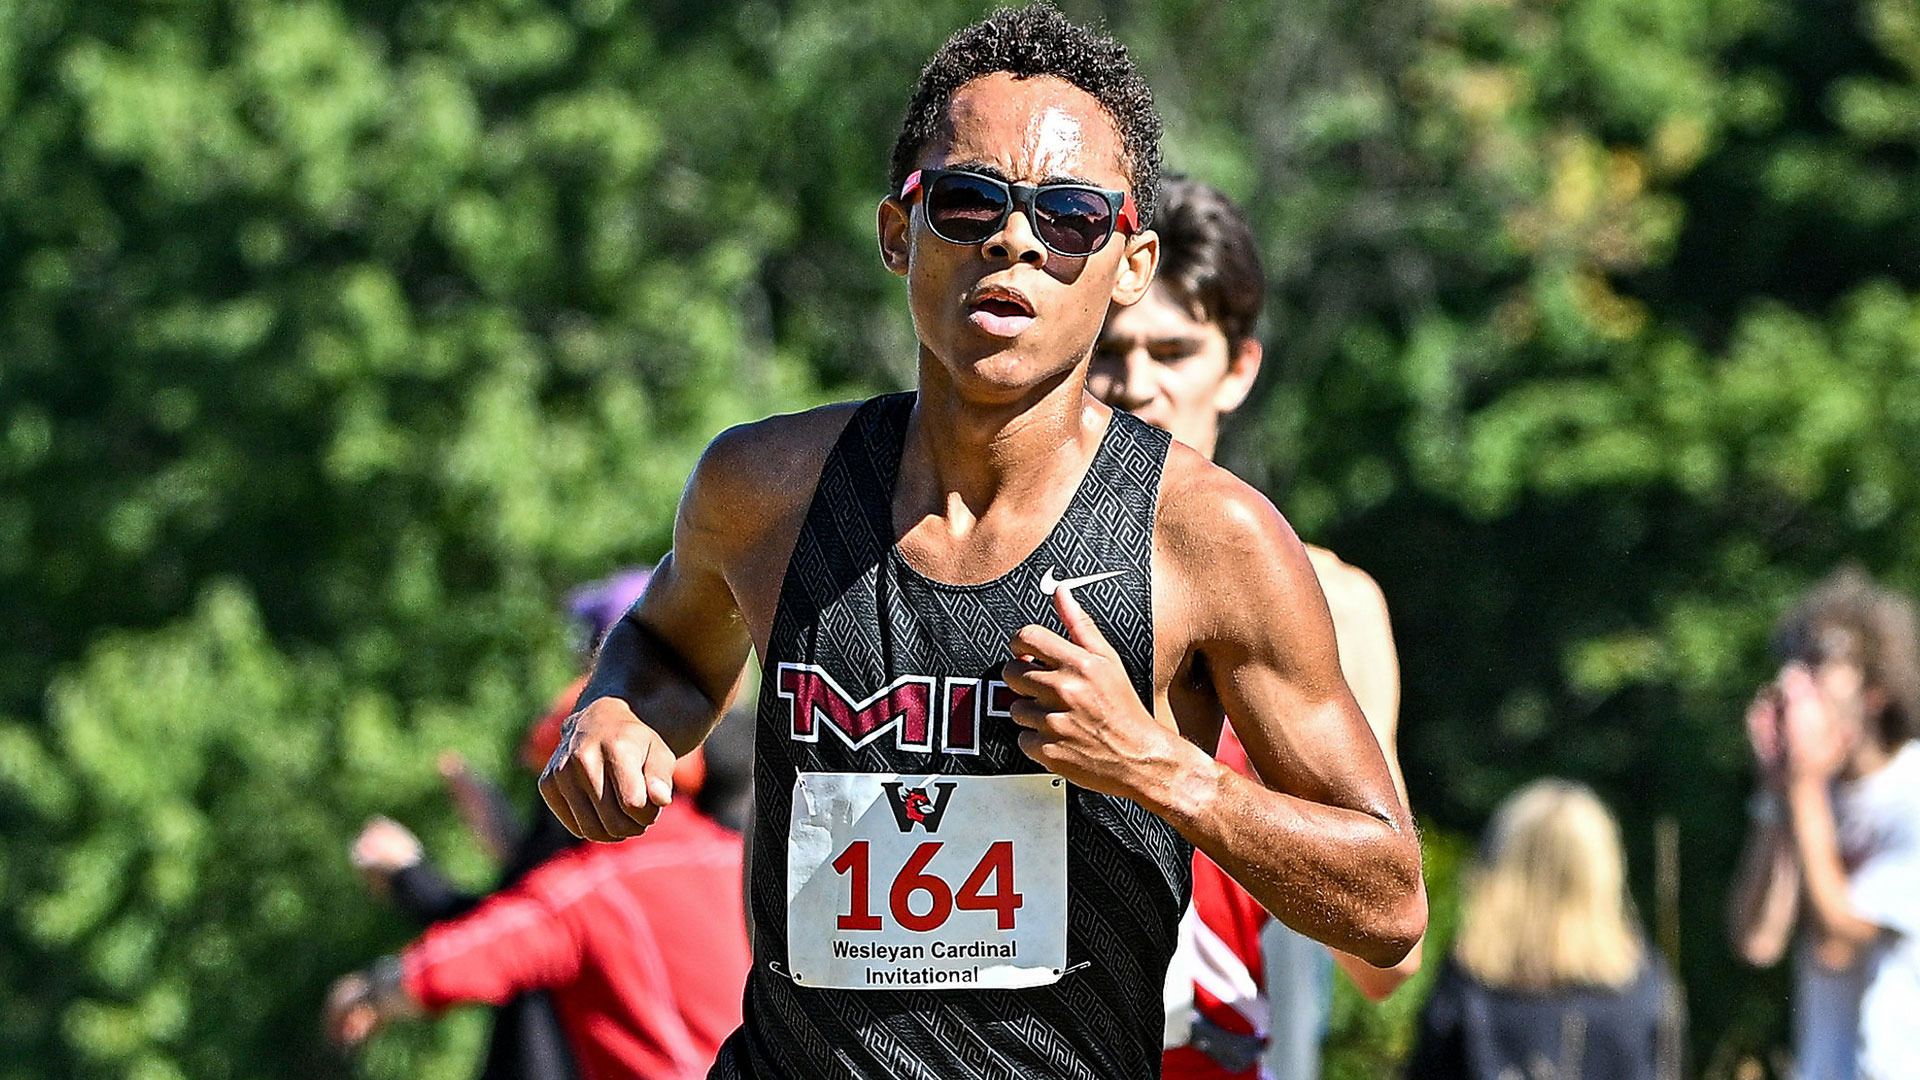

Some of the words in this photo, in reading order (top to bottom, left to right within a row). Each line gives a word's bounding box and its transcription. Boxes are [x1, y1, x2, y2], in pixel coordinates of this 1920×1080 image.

[832, 841, 1023, 931] 164
[832, 941, 924, 961] Wesleyan
[931, 940, 1016, 957] Cardinal
[866, 967, 978, 984] Invitational
